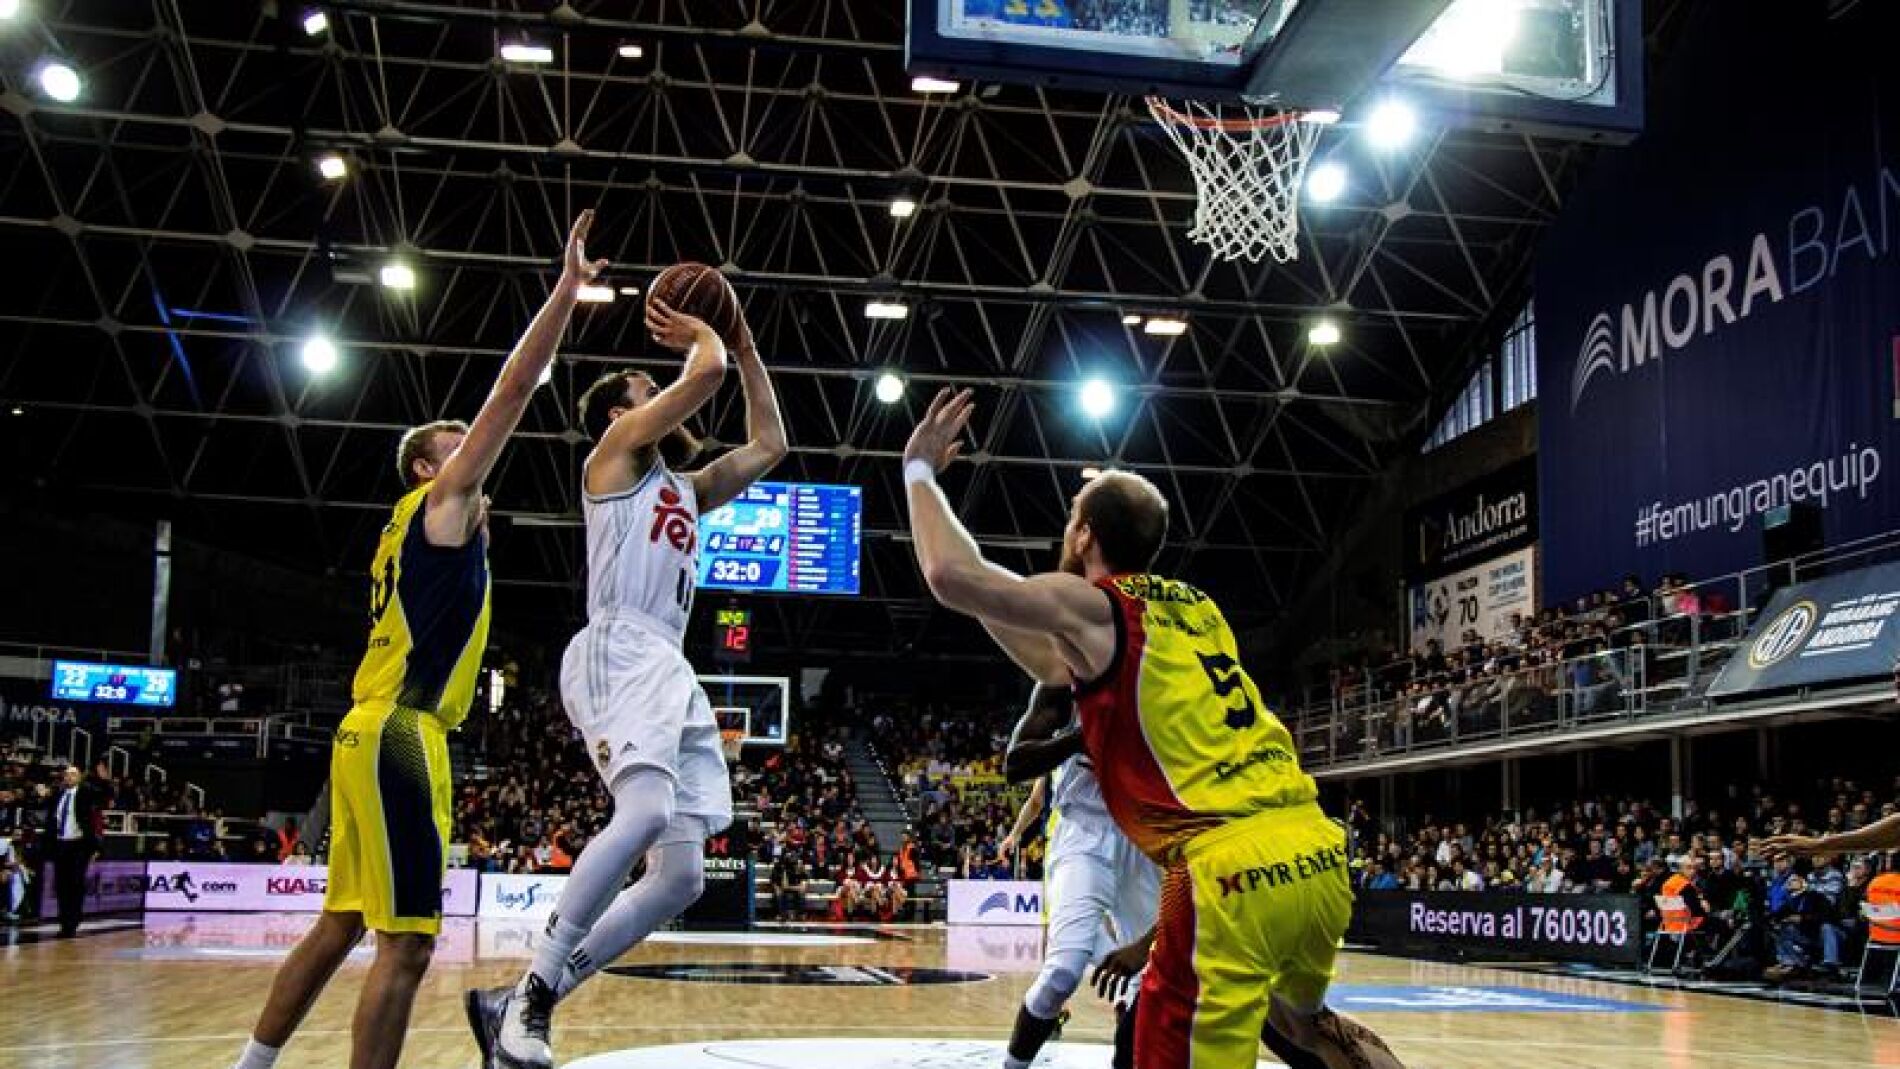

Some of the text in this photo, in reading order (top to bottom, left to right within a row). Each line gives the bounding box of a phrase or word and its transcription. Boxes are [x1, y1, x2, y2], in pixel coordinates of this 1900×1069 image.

[1635, 443, 1880, 548] #femungranequip
[1443, 491, 1526, 549] Andorra
[713, 560, 761, 581] 32:0
[1458, 594, 1479, 627] 70
[725, 626, 748, 649] 12
[1196, 650, 1256, 730] 5
[1410, 902, 1628, 947] Reserva al 760303
